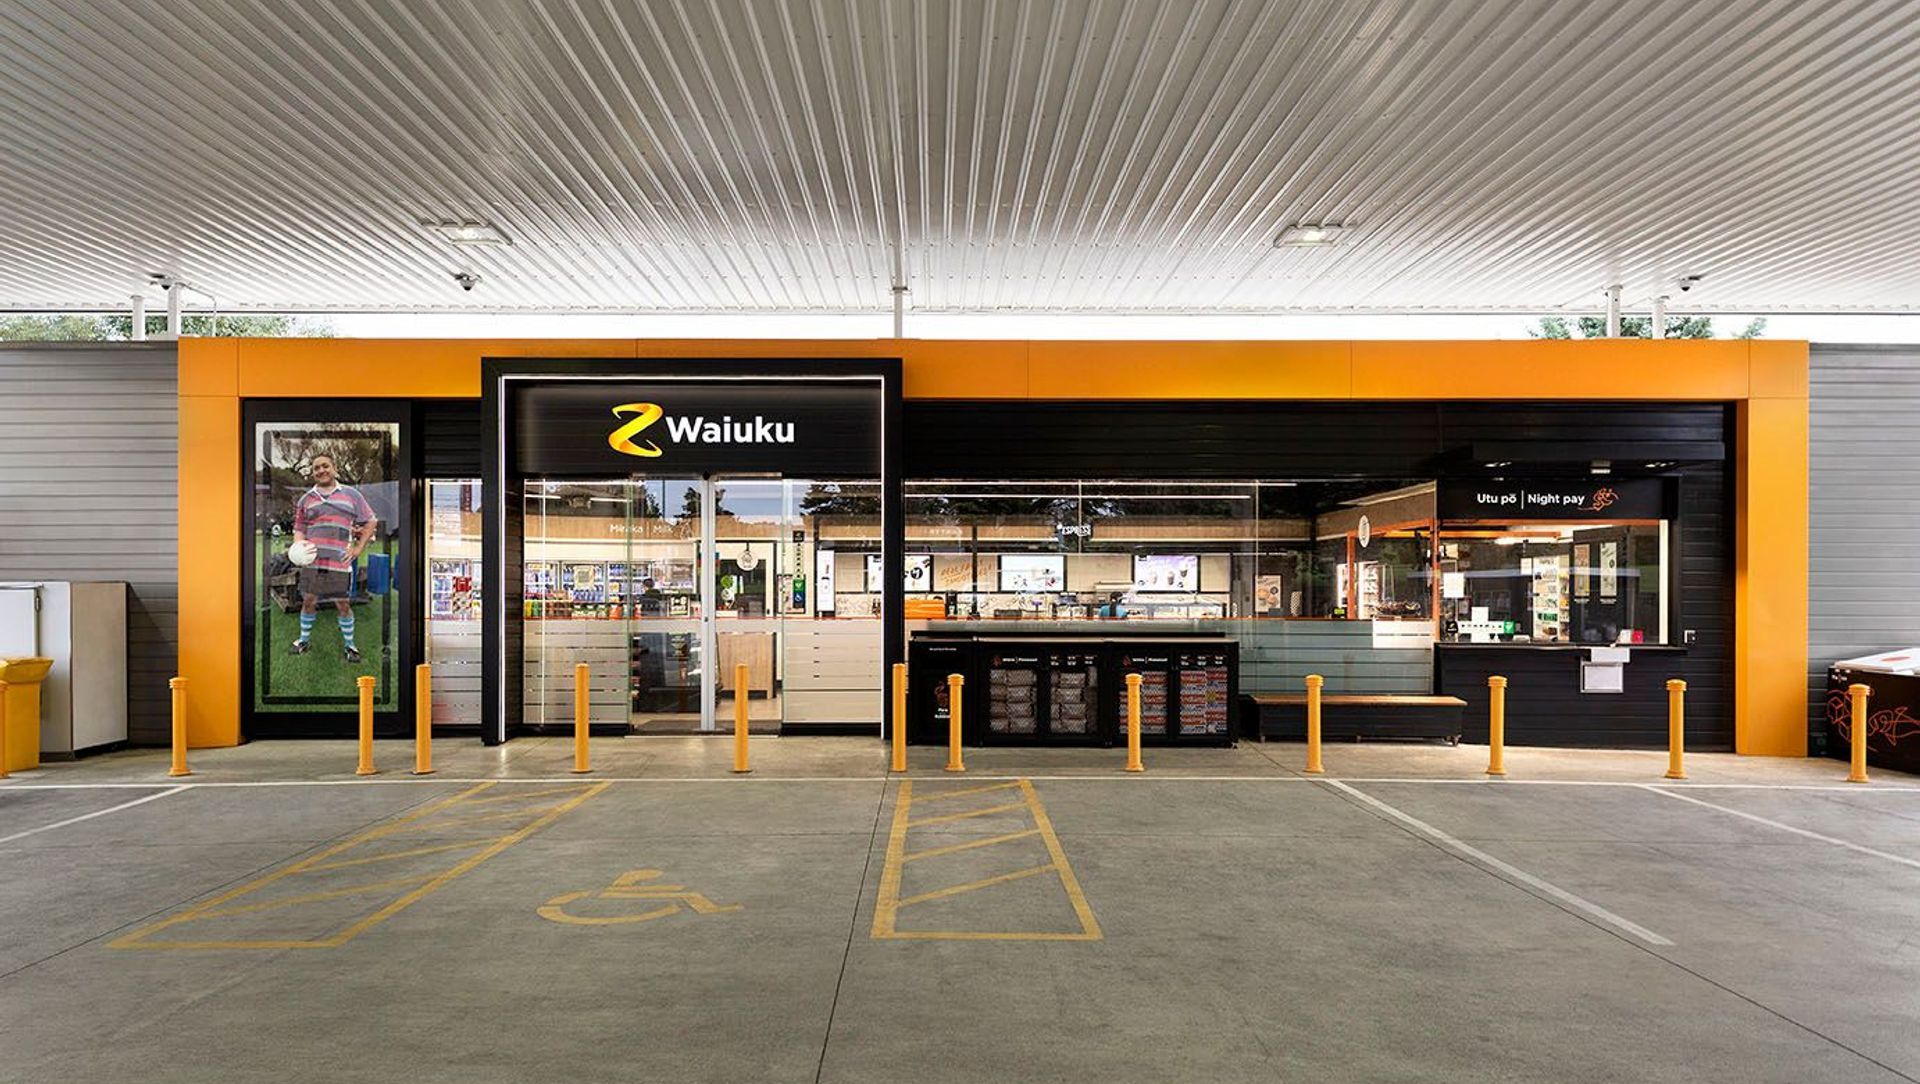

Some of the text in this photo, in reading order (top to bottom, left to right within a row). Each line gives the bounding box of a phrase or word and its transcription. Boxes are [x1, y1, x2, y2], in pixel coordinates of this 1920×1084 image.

[665, 416, 795, 443] Waiuku
[1477, 493, 1498, 504] Utu
[1527, 493, 1560, 506] Night
[1563, 495, 1585, 506] pay
